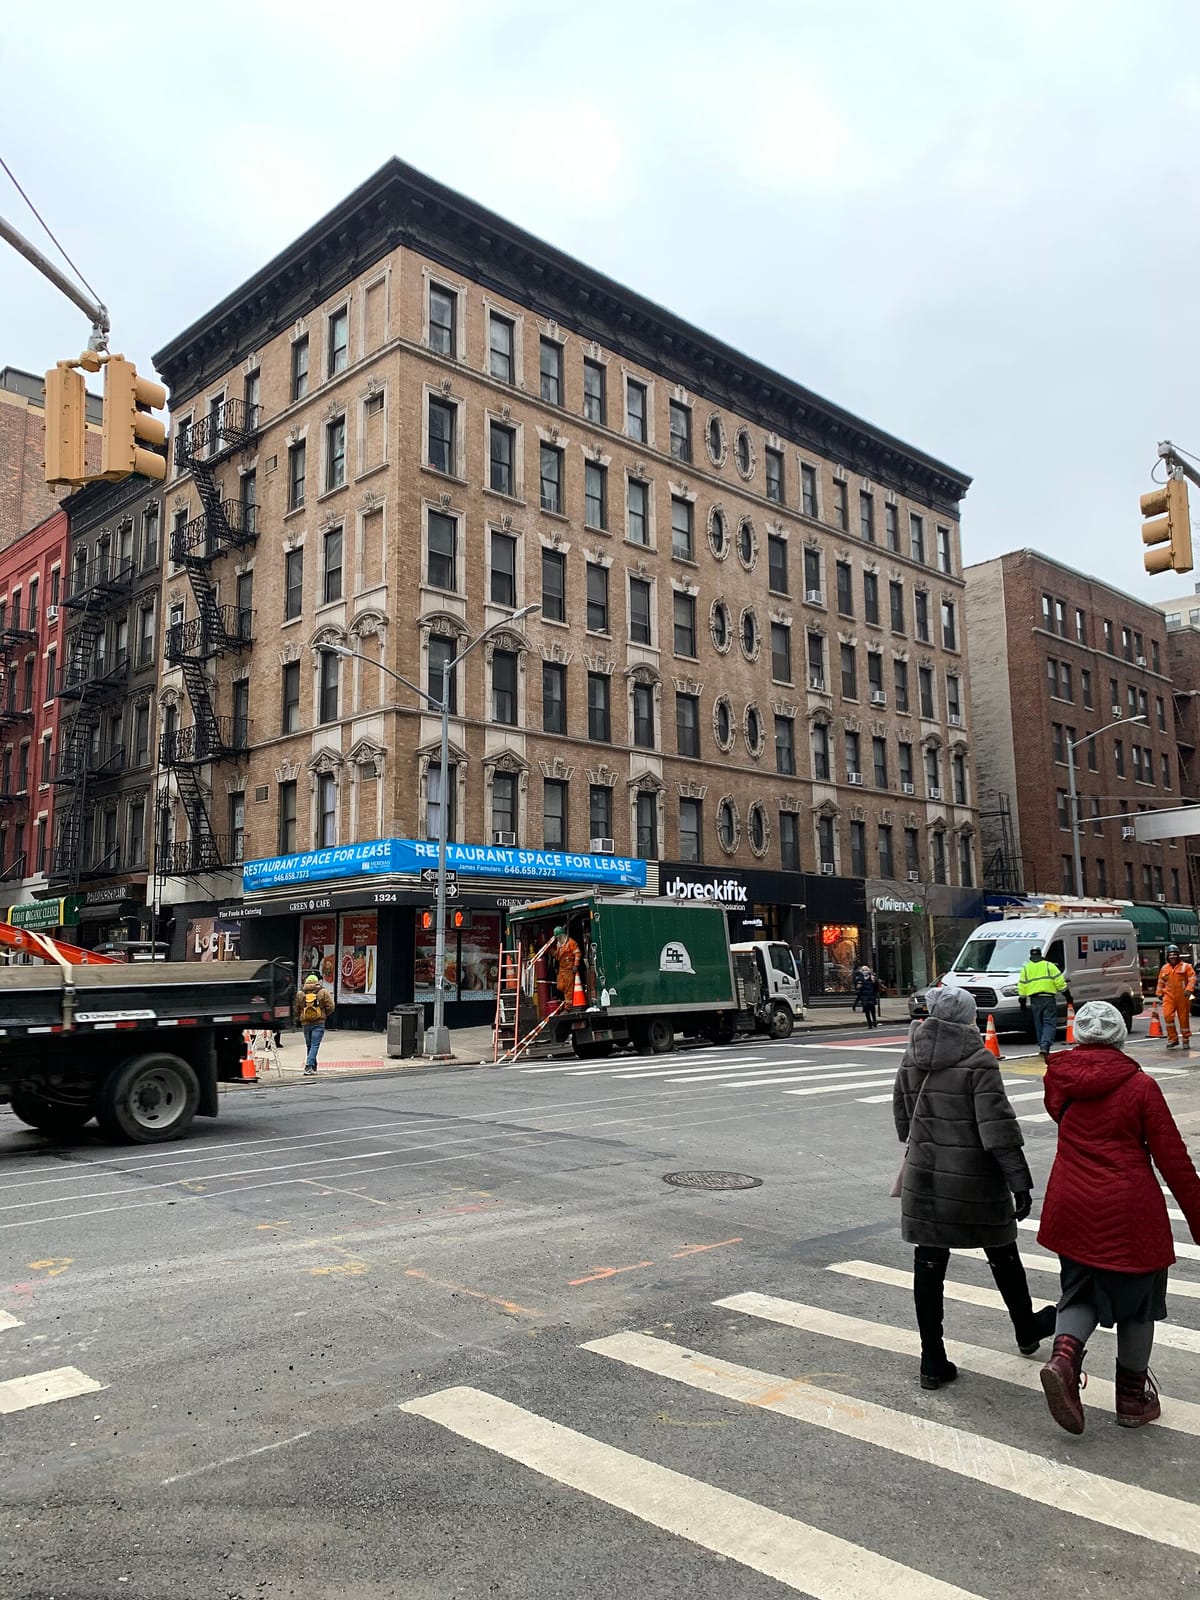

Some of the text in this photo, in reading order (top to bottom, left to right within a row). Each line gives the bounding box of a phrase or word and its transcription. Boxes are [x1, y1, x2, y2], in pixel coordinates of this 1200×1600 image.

[243, 856, 300, 877] RESTAURANT
[300, 851, 331, 867] SPACE
[333, 848, 355, 863] FOR
[356, 842, 391, 859] LEASE
[518, 851, 563, 867] SPACE
[565, 856, 592, 869] FOR
[594, 858, 632, 872] LEASE
[504, 865, 556, 876] 646.658.7373
[273, 870, 309, 883] 646.658.7373
[374, 894, 397, 902] 1324
[496, 898, 522, 907] GREEN
[289, 899, 331, 911] GREEN CAFE
[244, 908, 262, 916] Catering
[977, 931, 1040, 939] LIPPOLIS
[1092, 938, 1127, 952] LIPPOLIS
